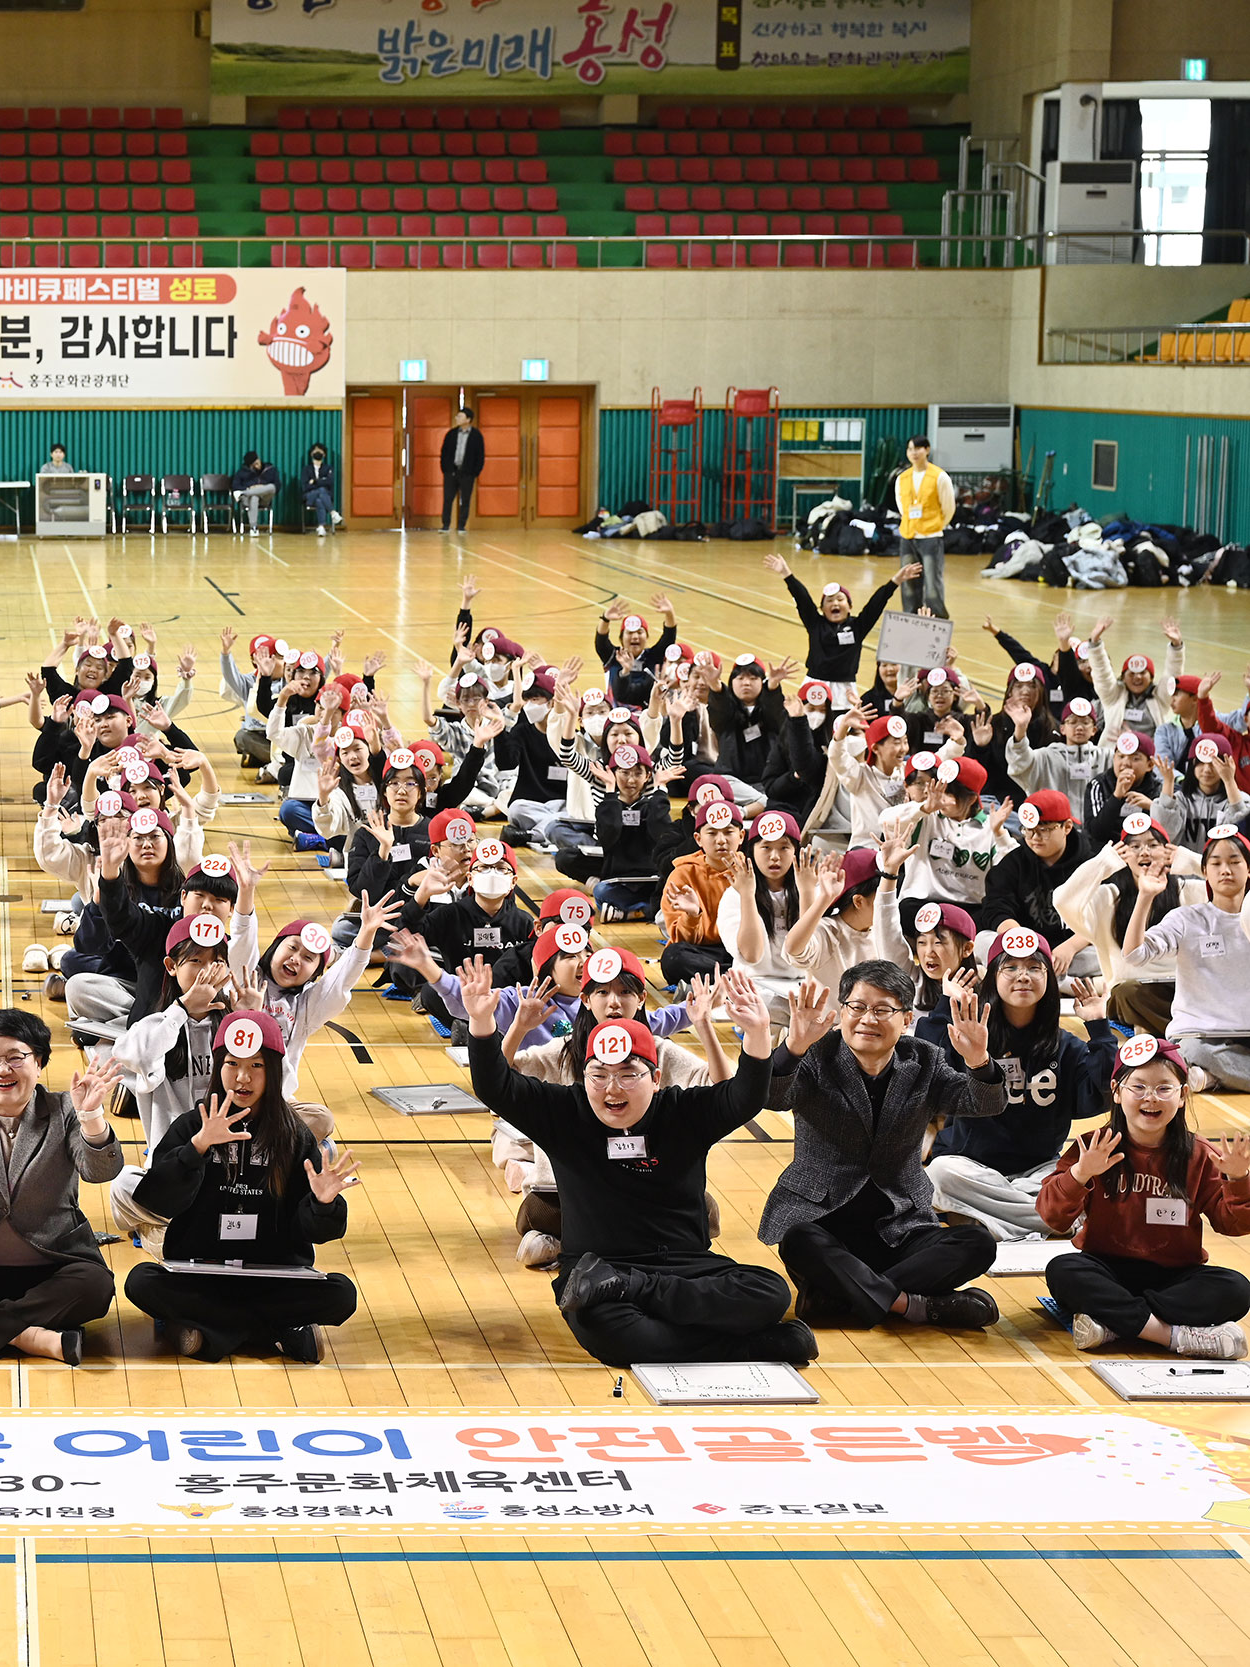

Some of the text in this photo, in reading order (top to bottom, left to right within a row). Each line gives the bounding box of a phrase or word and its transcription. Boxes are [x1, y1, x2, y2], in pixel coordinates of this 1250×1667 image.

[831, 22, 884, 38] 행복한
[892, 22, 927, 37] 복지
[377, 0, 676, 84] 밝은미래 홍성
[169, 277, 217, 302] 성료
[60, 315, 238, 358] 감사합니다
[28, 373, 129, 389] 홍주문화관광재단
[134, 657, 149, 666] 175
[301, 655, 317, 667] 203
[1018, 667, 1031, 677] 94
[585, 691, 602, 702] 214
[811, 690, 823, 700] 55
[1075, 702, 1087, 712] 31
[611, 710, 629, 720] 160
[893, 720, 903, 732] 10
[336, 731, 352, 743] 199
[1122, 737, 1134, 751] 48
[616, 746, 636, 766] 202
[1198, 744, 1217, 757] 152
[392, 754, 413, 764] 167
[128, 765, 147, 779] 33
[98, 799, 121, 812] 116
[132, 814, 157, 827] 169
[708, 807, 730, 824] 242
[1022, 810, 1035, 823] 52
[760, 819, 785, 836] 223
[1130, 818, 1145, 829] 16
[449, 824, 467, 838] 78
[1216, 827, 1232, 835] 15
[481, 844, 499, 858] 58
[203, 859, 227, 872] 224
[566, 906, 584, 919] 75
[917, 909, 939, 924] 262
[194, 923, 220, 939] 171
[305, 928, 327, 950] 30
[562, 931, 582, 946] 50
[1005, 935, 1036, 950] 238
[596, 958, 614, 975] 12
[233, 1029, 255, 1049] 81
[598, 1036, 628, 1055] 121
[1123, 1039, 1156, 1061] 255
[53, 1428, 413, 1462] 어린이
[454, 1424, 1060, 1466] 안전골든벨
[175, 1469, 633, 1495] 홍주문화체육센터
[238, 1504, 394, 1518] 홍성경찰서
[499, 1503, 655, 1517] 홍성소방서
[739, 1502, 889, 1515] 중도일보
